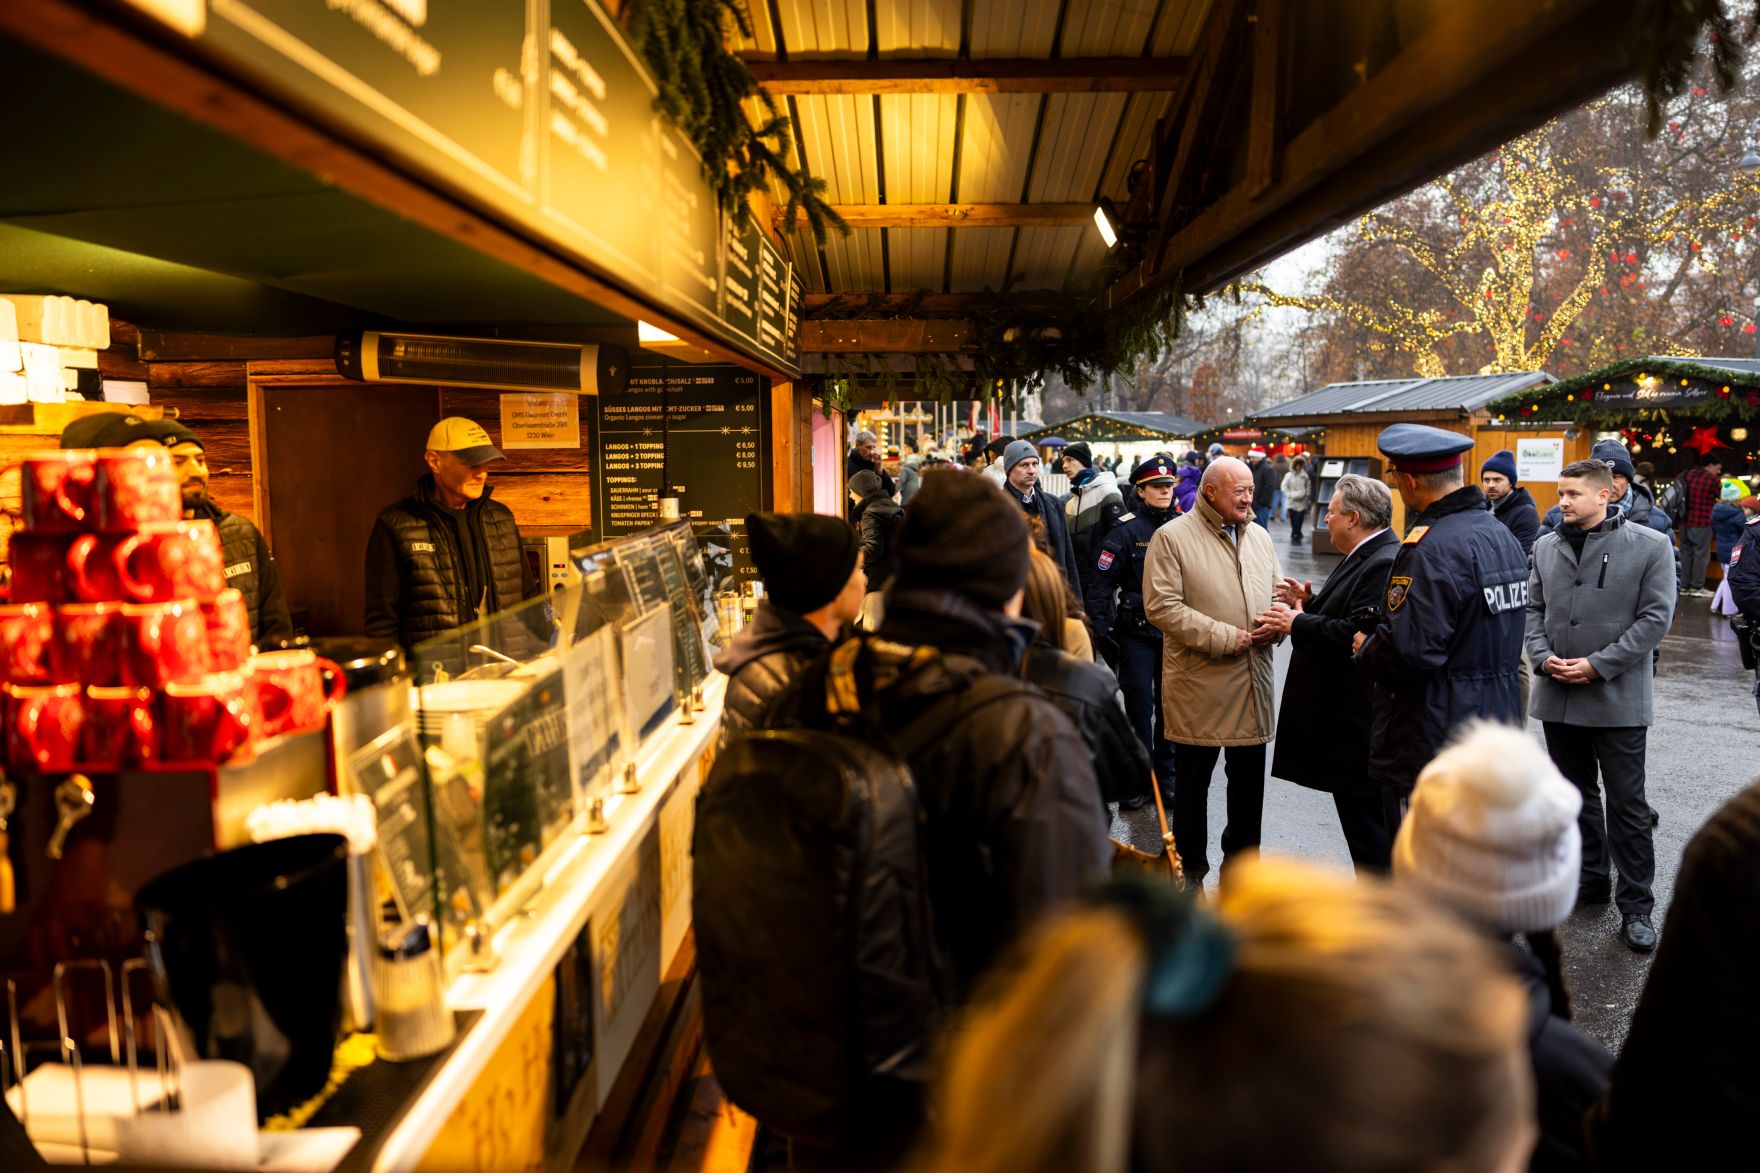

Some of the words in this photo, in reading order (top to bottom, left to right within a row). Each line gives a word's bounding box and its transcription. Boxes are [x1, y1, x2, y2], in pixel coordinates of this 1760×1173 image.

[627, 405, 651, 413] LANGOS
[651, 405, 662, 413] MIT
[741, 404, 755, 412] 5,00
[604, 414, 625, 422] Organic
[625, 414, 645, 422] Langos
[639, 442, 664, 450] TOPPING
[741, 441, 755, 449] 6,50
[736, 451, 741, 459] €
[741, 451, 755, 459] 8,00
[605, 462, 630, 470] LANGOS
[742, 461, 755, 469] 9,50
[606, 476, 638, 484] TOPPINGS:
